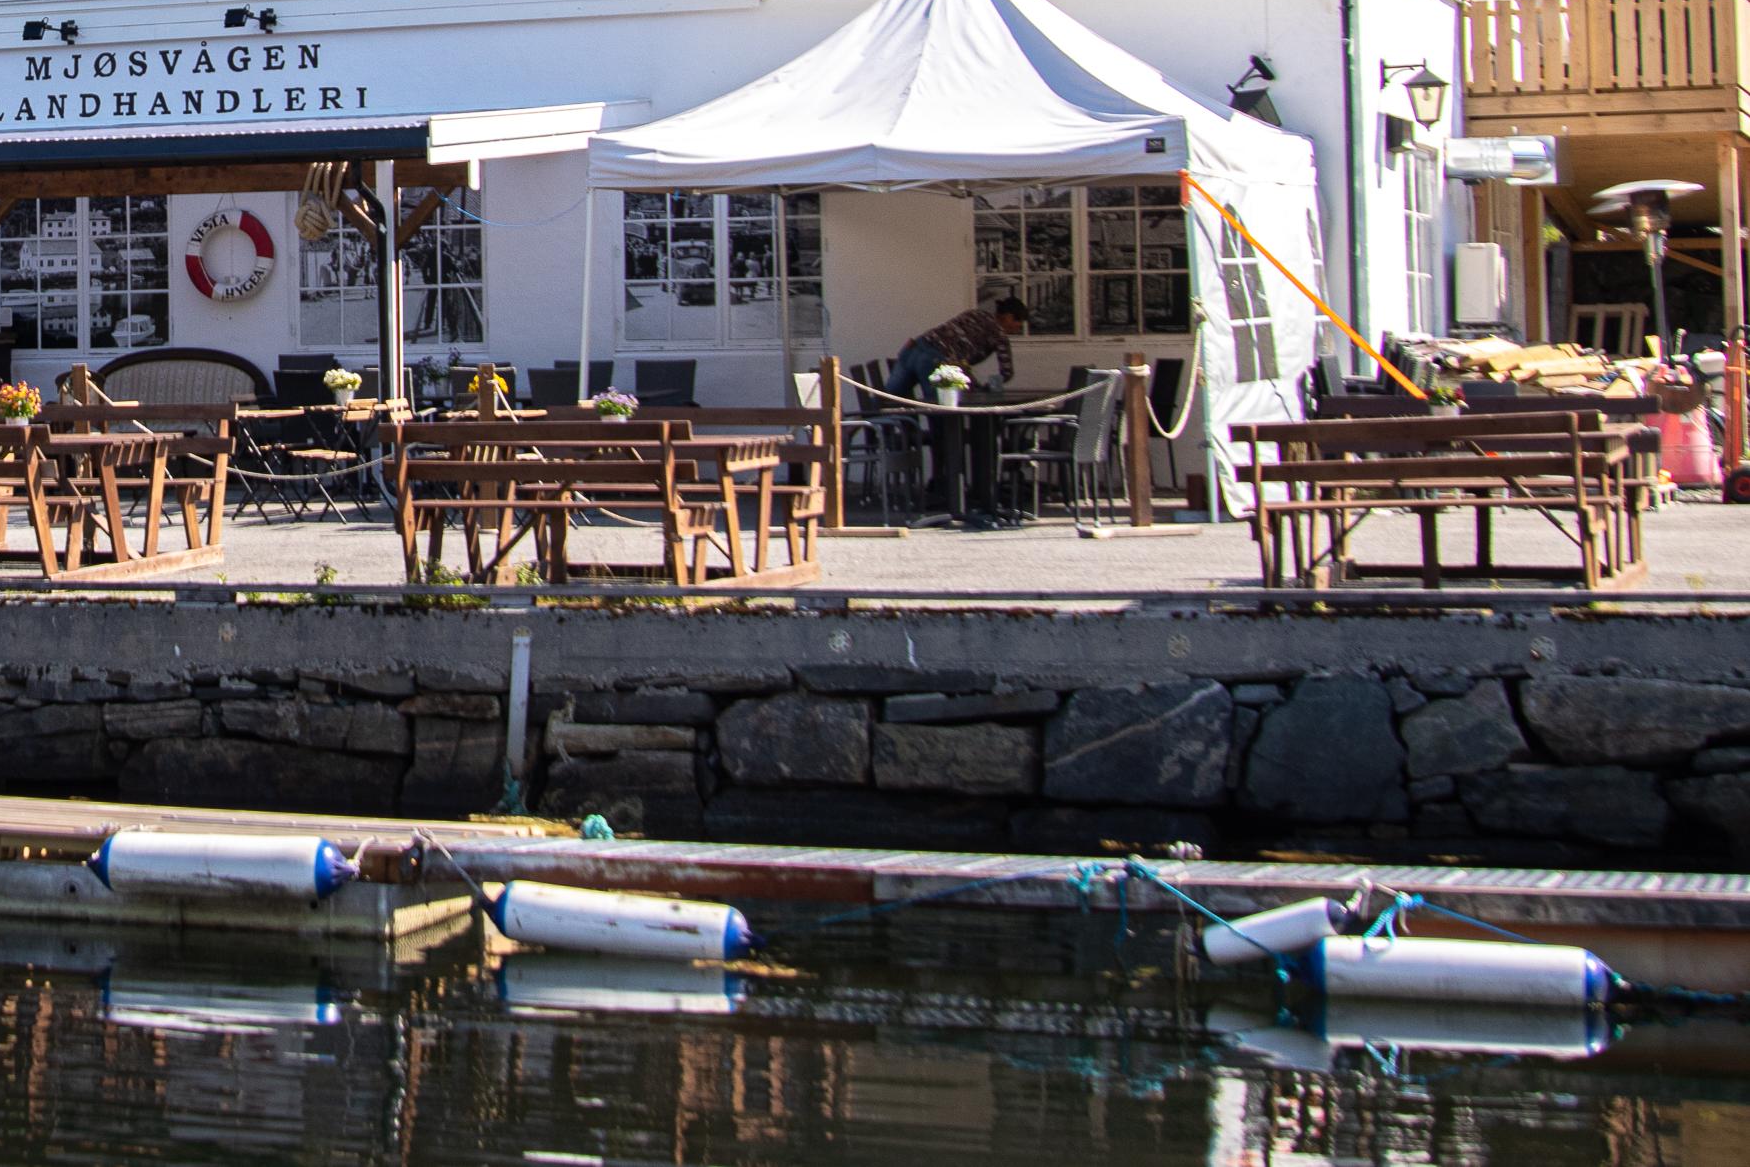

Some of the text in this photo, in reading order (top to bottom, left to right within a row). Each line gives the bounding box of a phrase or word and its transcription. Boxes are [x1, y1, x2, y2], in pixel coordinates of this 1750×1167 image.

[24, 40, 321, 81] MJØSVÅGEN
[191, 213, 230, 243] VESTA
[225, 270, 265, 299] HYGEA
